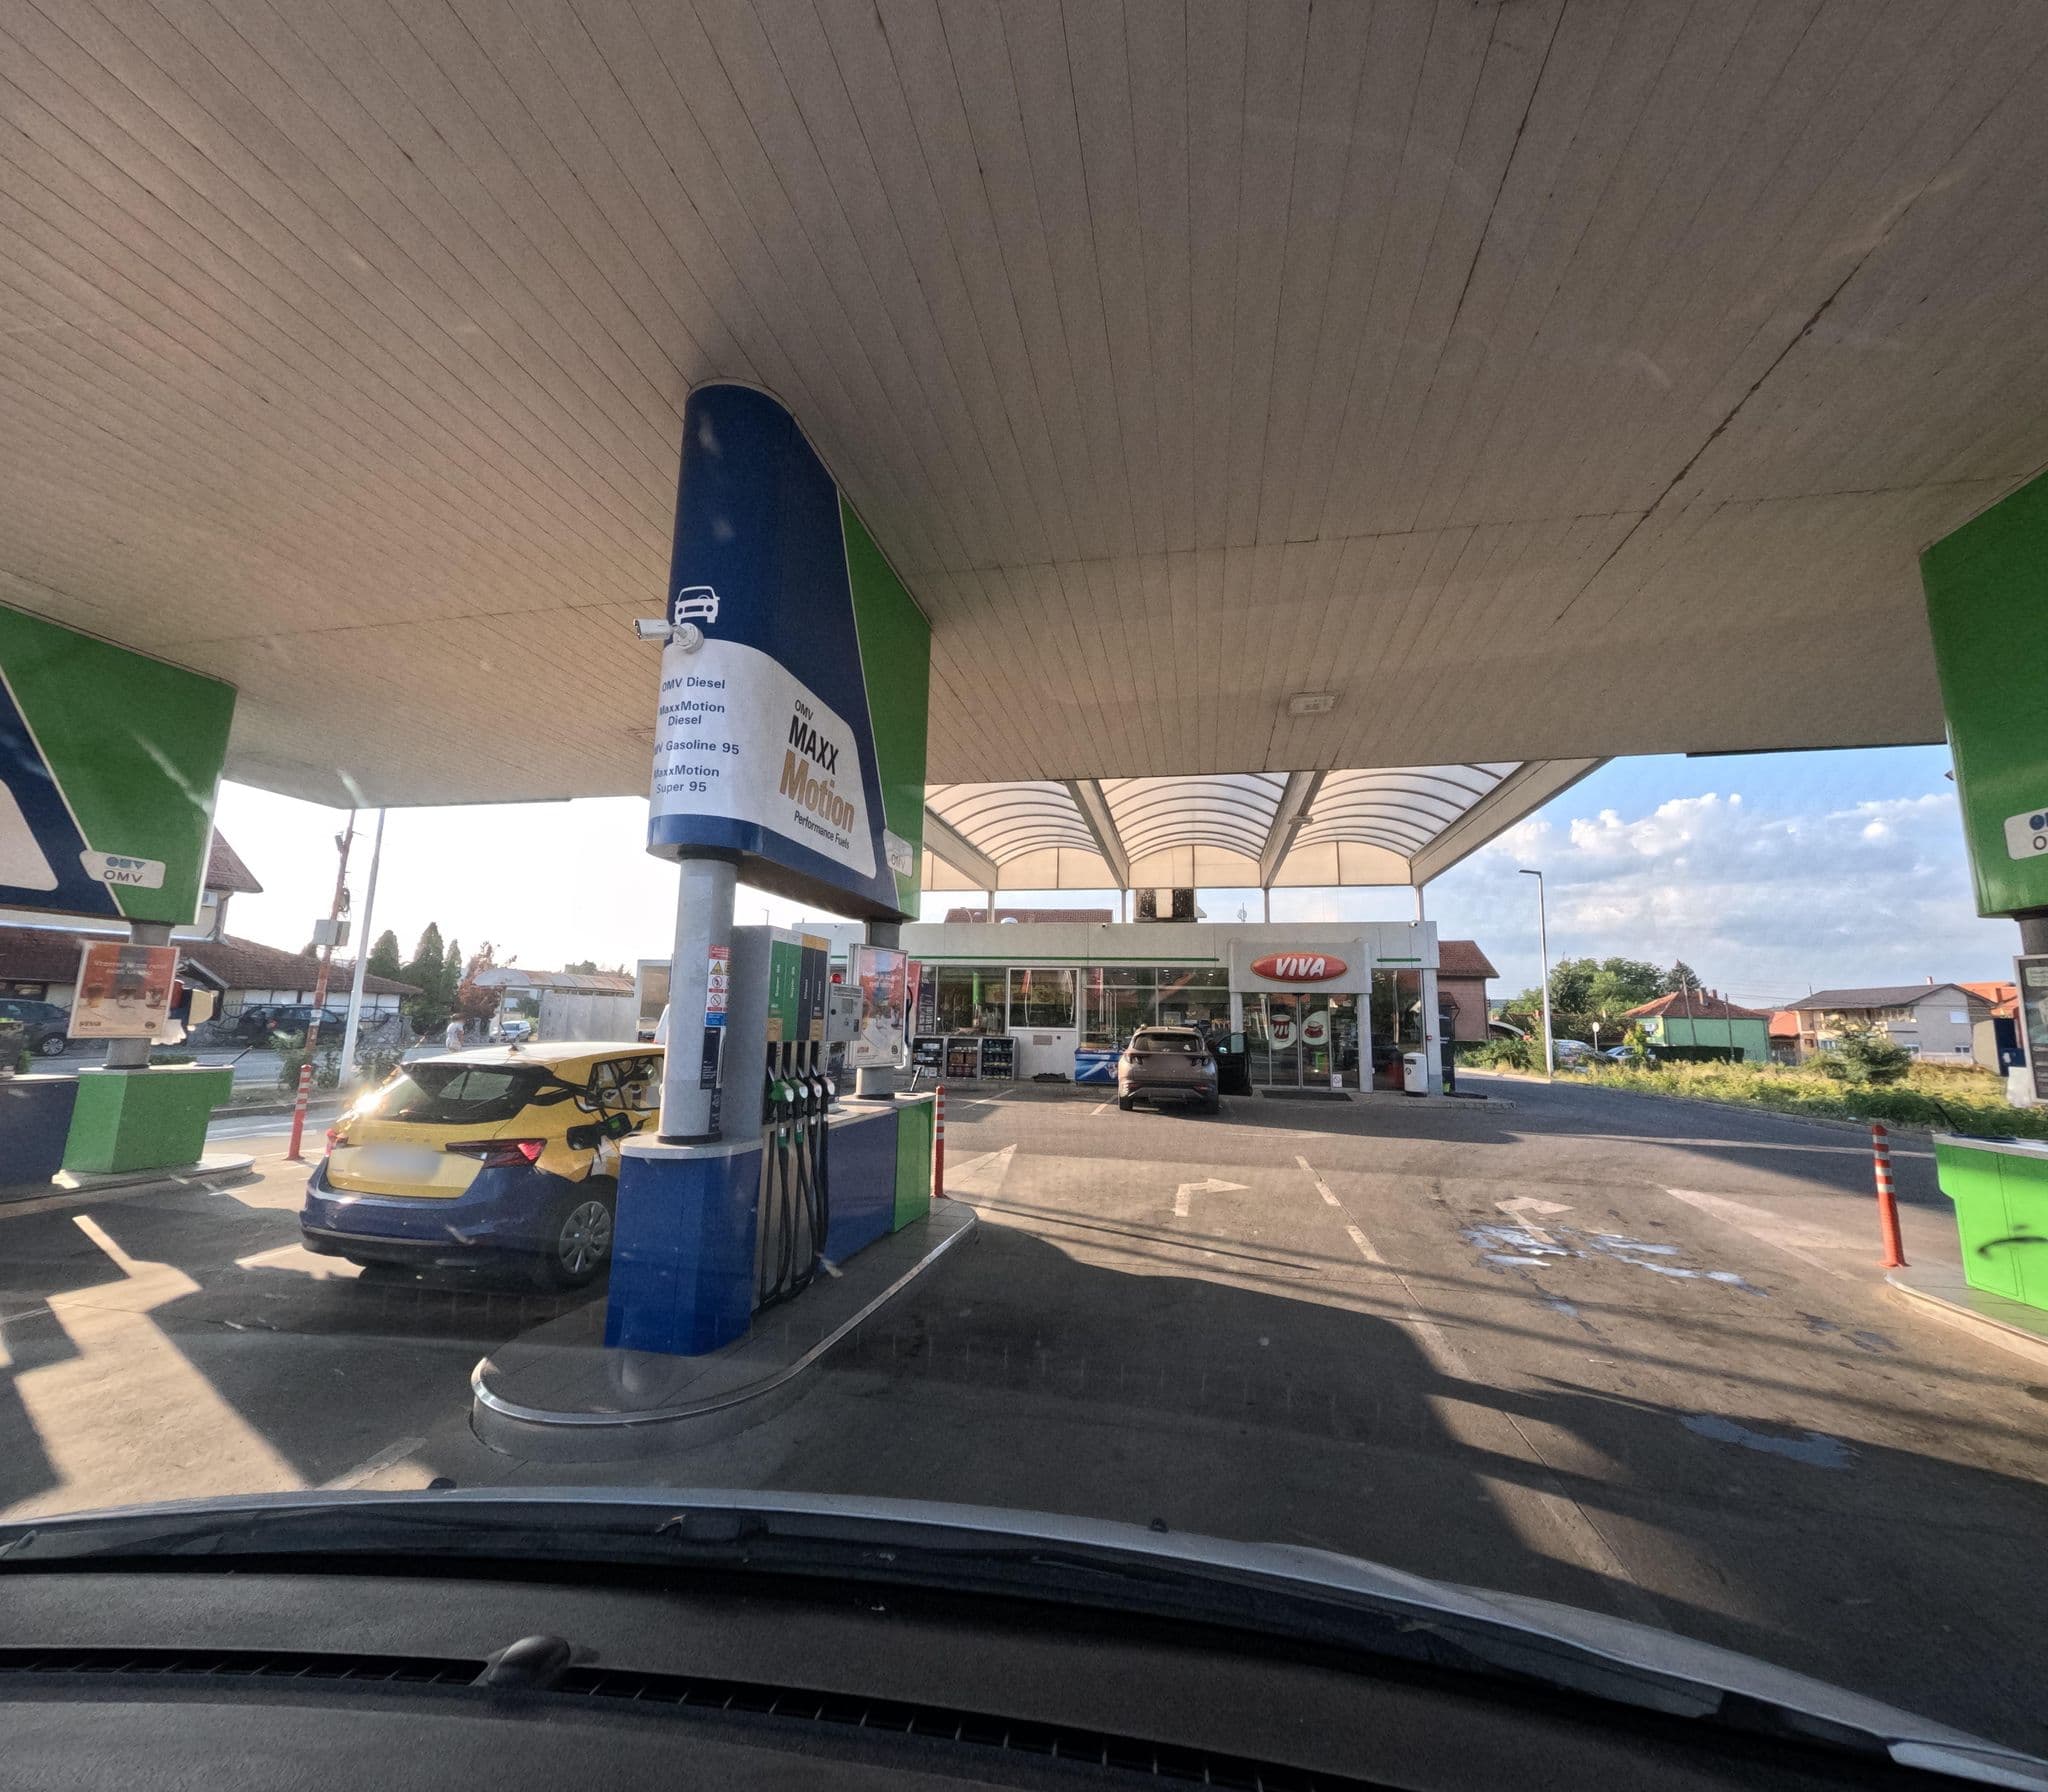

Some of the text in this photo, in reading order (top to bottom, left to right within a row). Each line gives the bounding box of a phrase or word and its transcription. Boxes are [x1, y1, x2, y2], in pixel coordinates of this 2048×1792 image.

[687, 676, 726, 689] Diesel
[794, 699, 814, 720] OMV
[667, 715, 702, 726] Diesel
[665, 739, 717, 752] Gasoline
[722, 742, 740, 755] 95
[788, 714, 839, 775] MAXX
[656, 780, 707, 794] Super 95
[779, 749, 855, 834] Motion
[793, 810, 850, 850] Performance Fuels
[103, 870, 144, 884] OMV
[1275, 956, 1326, 977] VIVA
